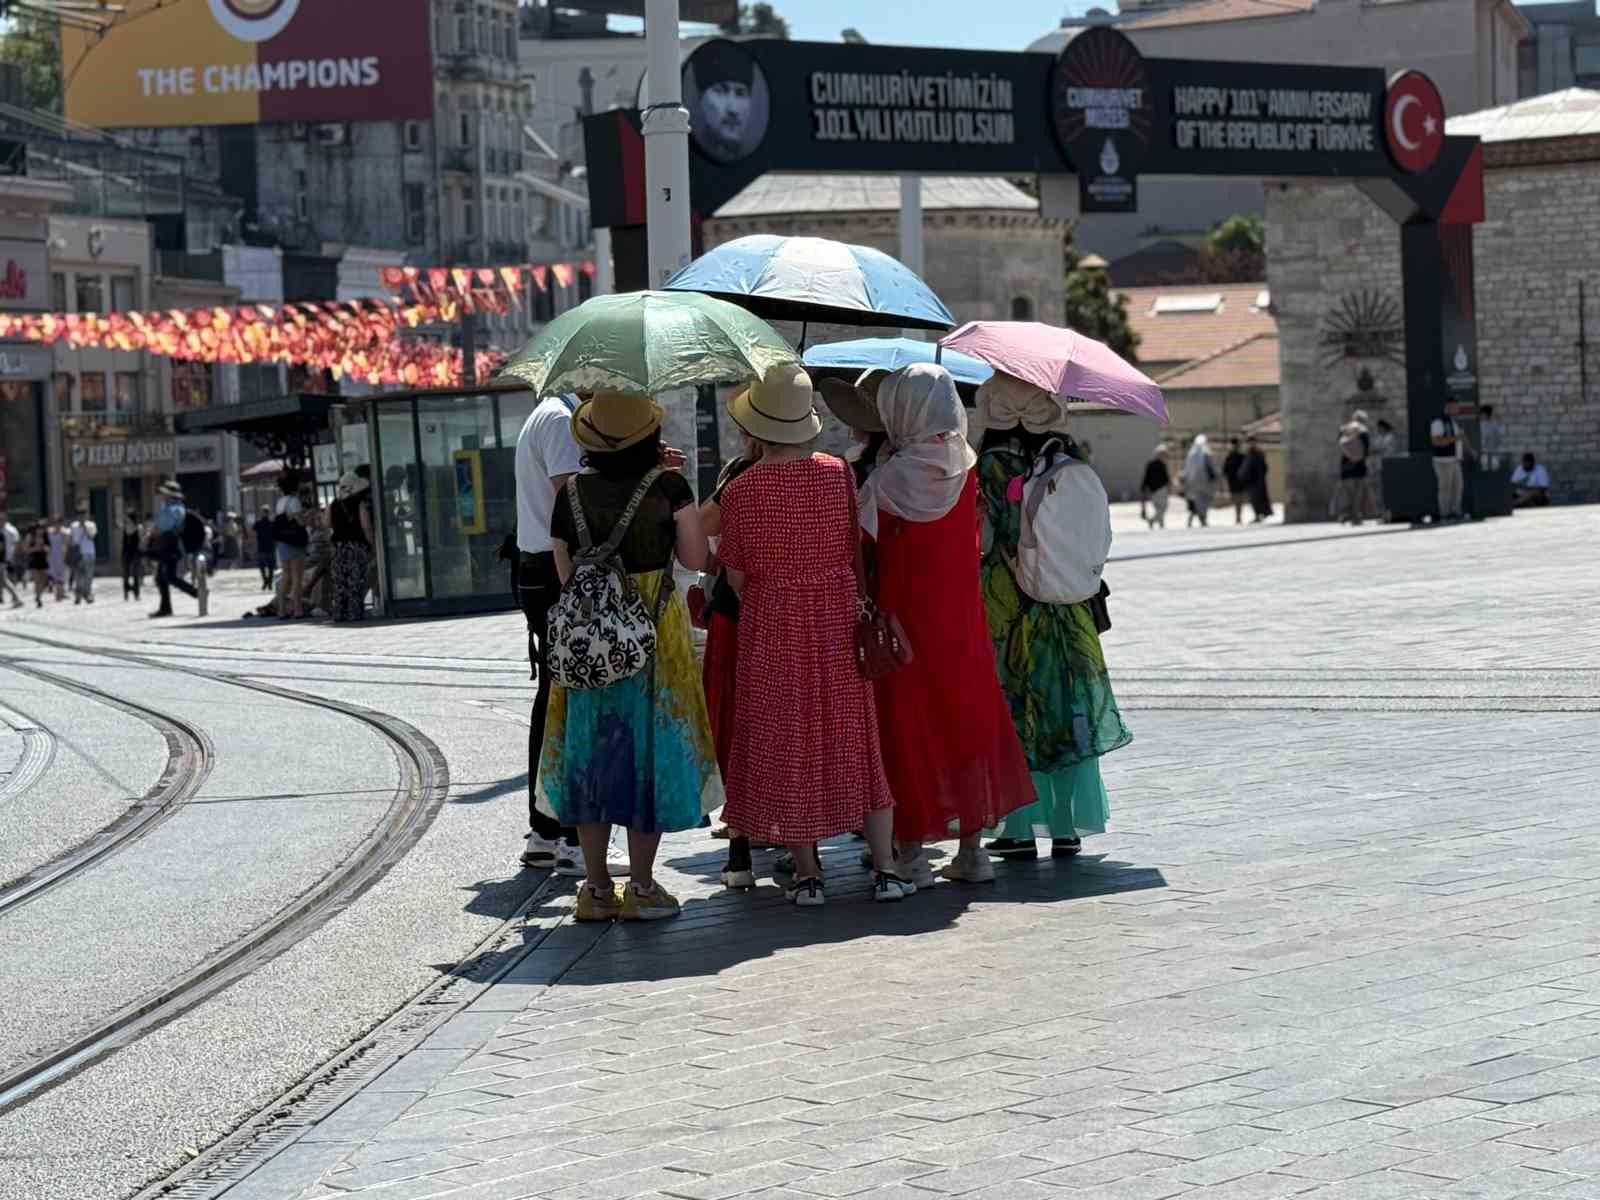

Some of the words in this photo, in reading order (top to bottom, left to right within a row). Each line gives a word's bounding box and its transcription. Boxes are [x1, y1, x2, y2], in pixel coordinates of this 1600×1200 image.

[137, 67, 195, 96] THE
[203, 56, 379, 93] CHAMPIONS
[811, 69, 1013, 110] CUMHURİYETİMİZİN
[1174, 86, 1228, 116] HAPPY
[1268, 89, 1371, 119] ANNIVERSARY
[893, 110, 952, 142] KUTLU
[955, 111, 1014, 143] OLSUN
[1176, 120, 1197, 149] OF
[1197, 120, 1227, 149] THE
[1228, 121, 1295, 150] REPUBLIC
[1295, 122, 1316, 150] OF
